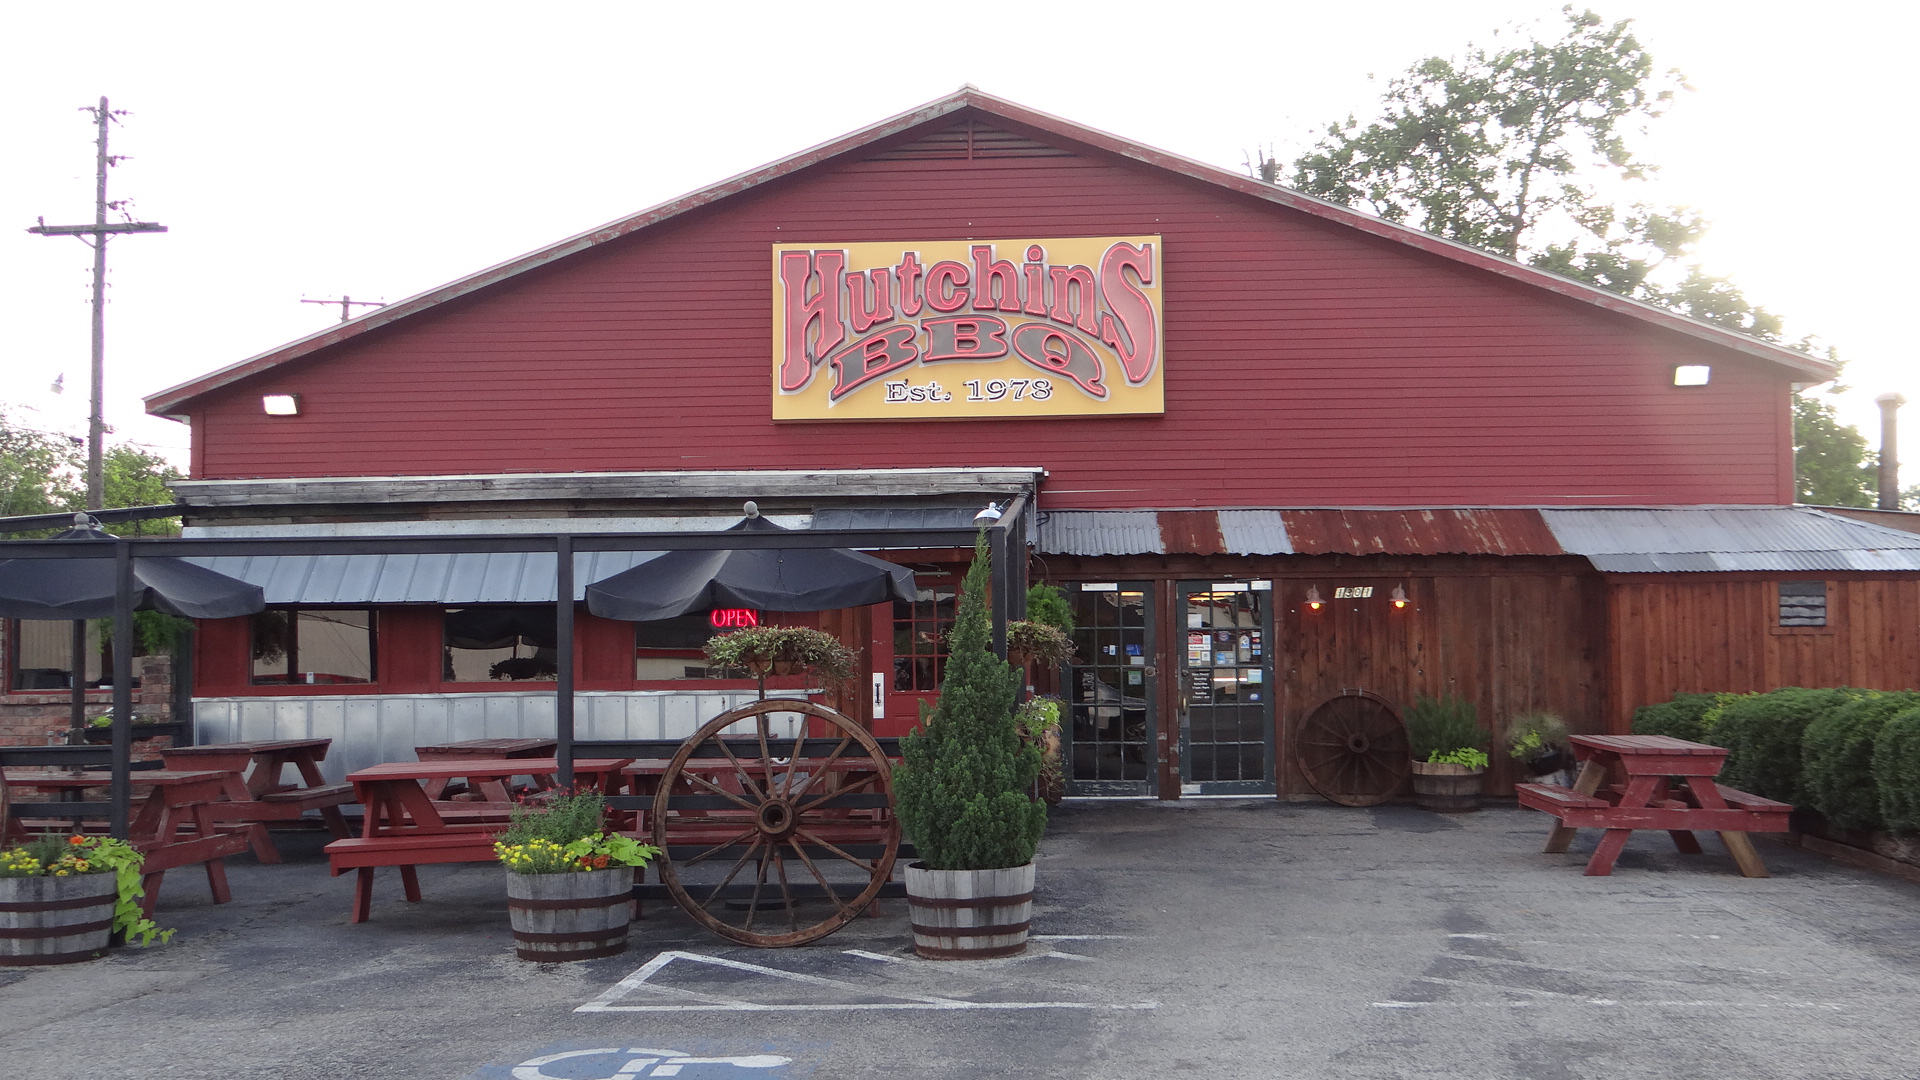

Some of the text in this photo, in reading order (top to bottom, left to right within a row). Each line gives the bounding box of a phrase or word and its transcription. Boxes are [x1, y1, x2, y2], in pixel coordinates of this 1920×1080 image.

[830, 314, 1108, 405] BBQ
[884, 379, 1053, 403] Est. 1978
[711, 608, 758, 627] OPEN
